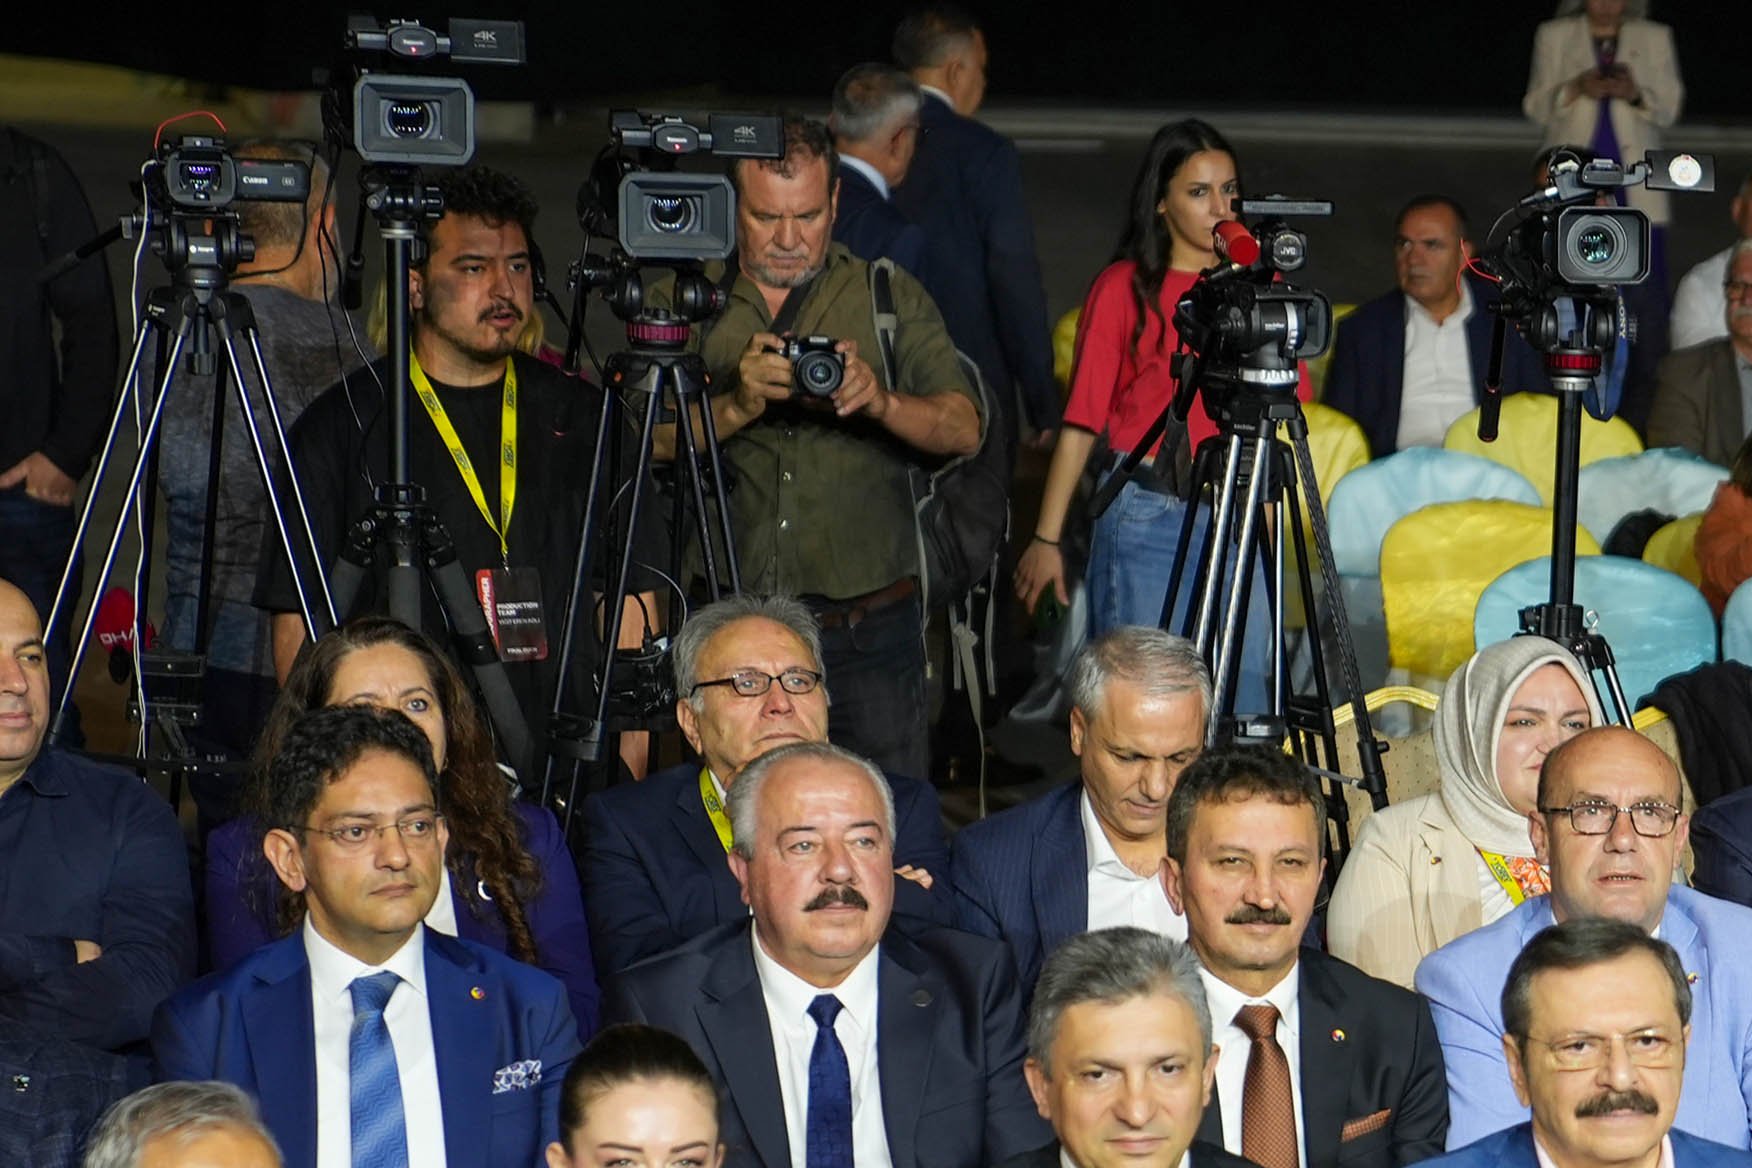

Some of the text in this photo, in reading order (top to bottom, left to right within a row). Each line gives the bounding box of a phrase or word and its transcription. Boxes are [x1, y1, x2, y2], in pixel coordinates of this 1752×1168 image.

[473, 30, 497, 41] 4K
[733, 125, 756, 137] 4K
[242, 176, 268, 185] Canon
[1281, 247, 1296, 256] JVC
